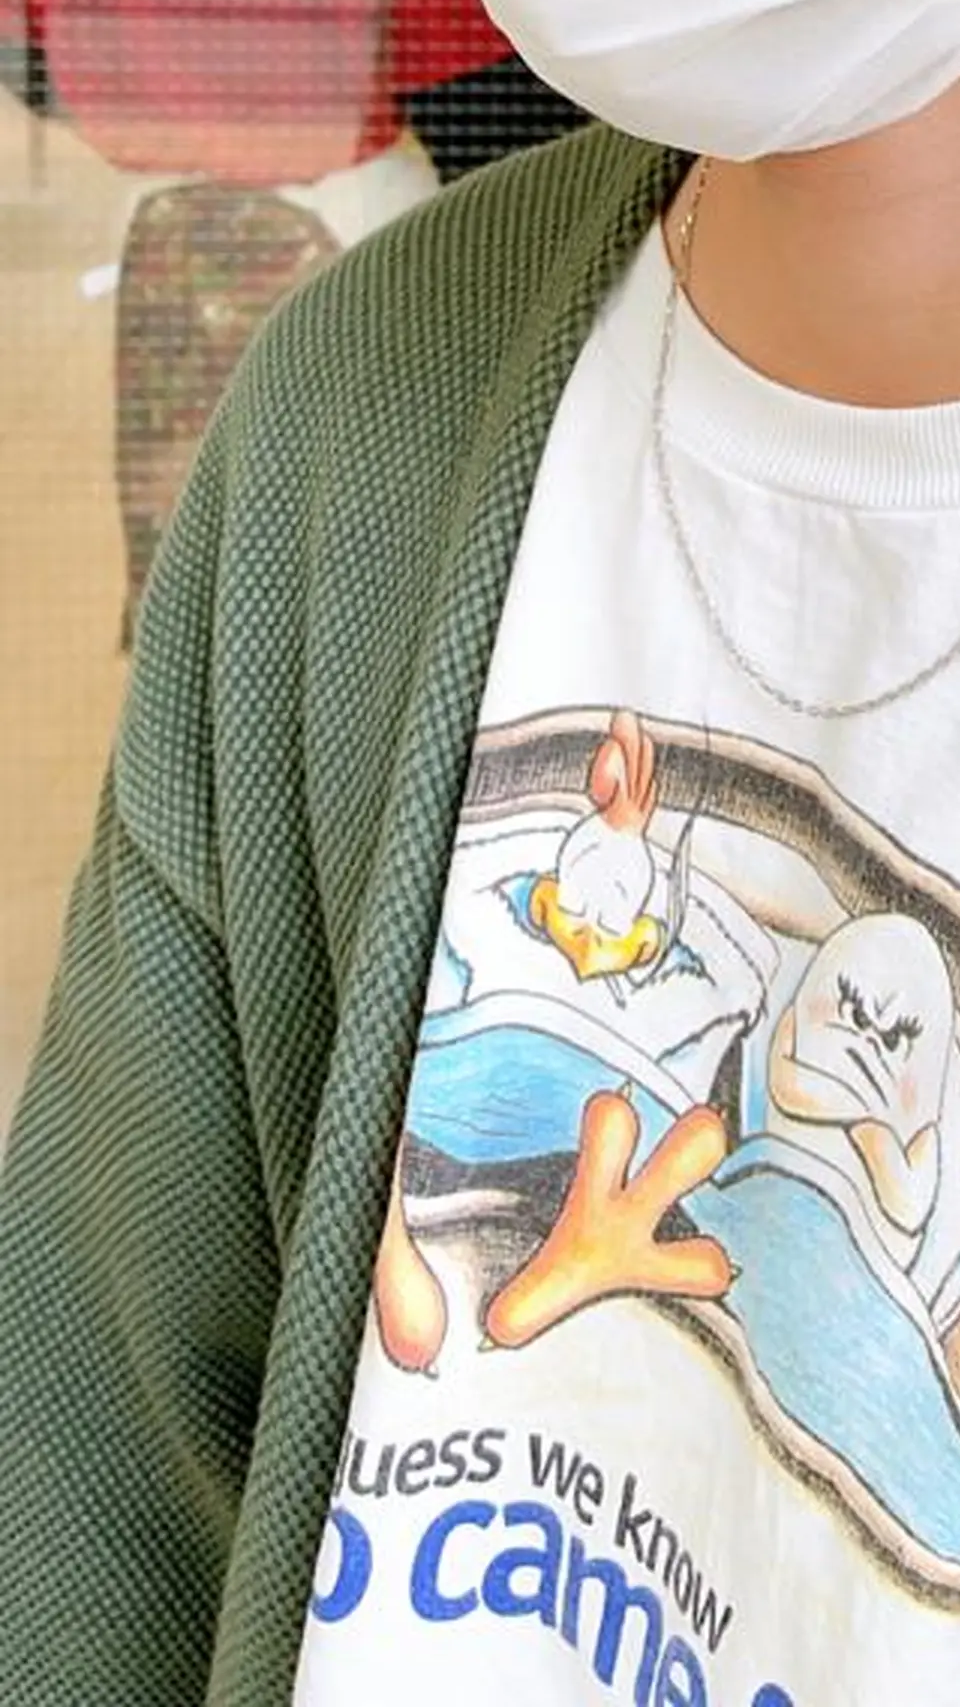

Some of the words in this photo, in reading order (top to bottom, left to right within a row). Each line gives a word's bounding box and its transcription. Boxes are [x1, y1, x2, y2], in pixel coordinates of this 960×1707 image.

[333, 1424, 507, 1499] uess
[528, 1433, 605, 1526] we
[613, 1474, 734, 1653] know
